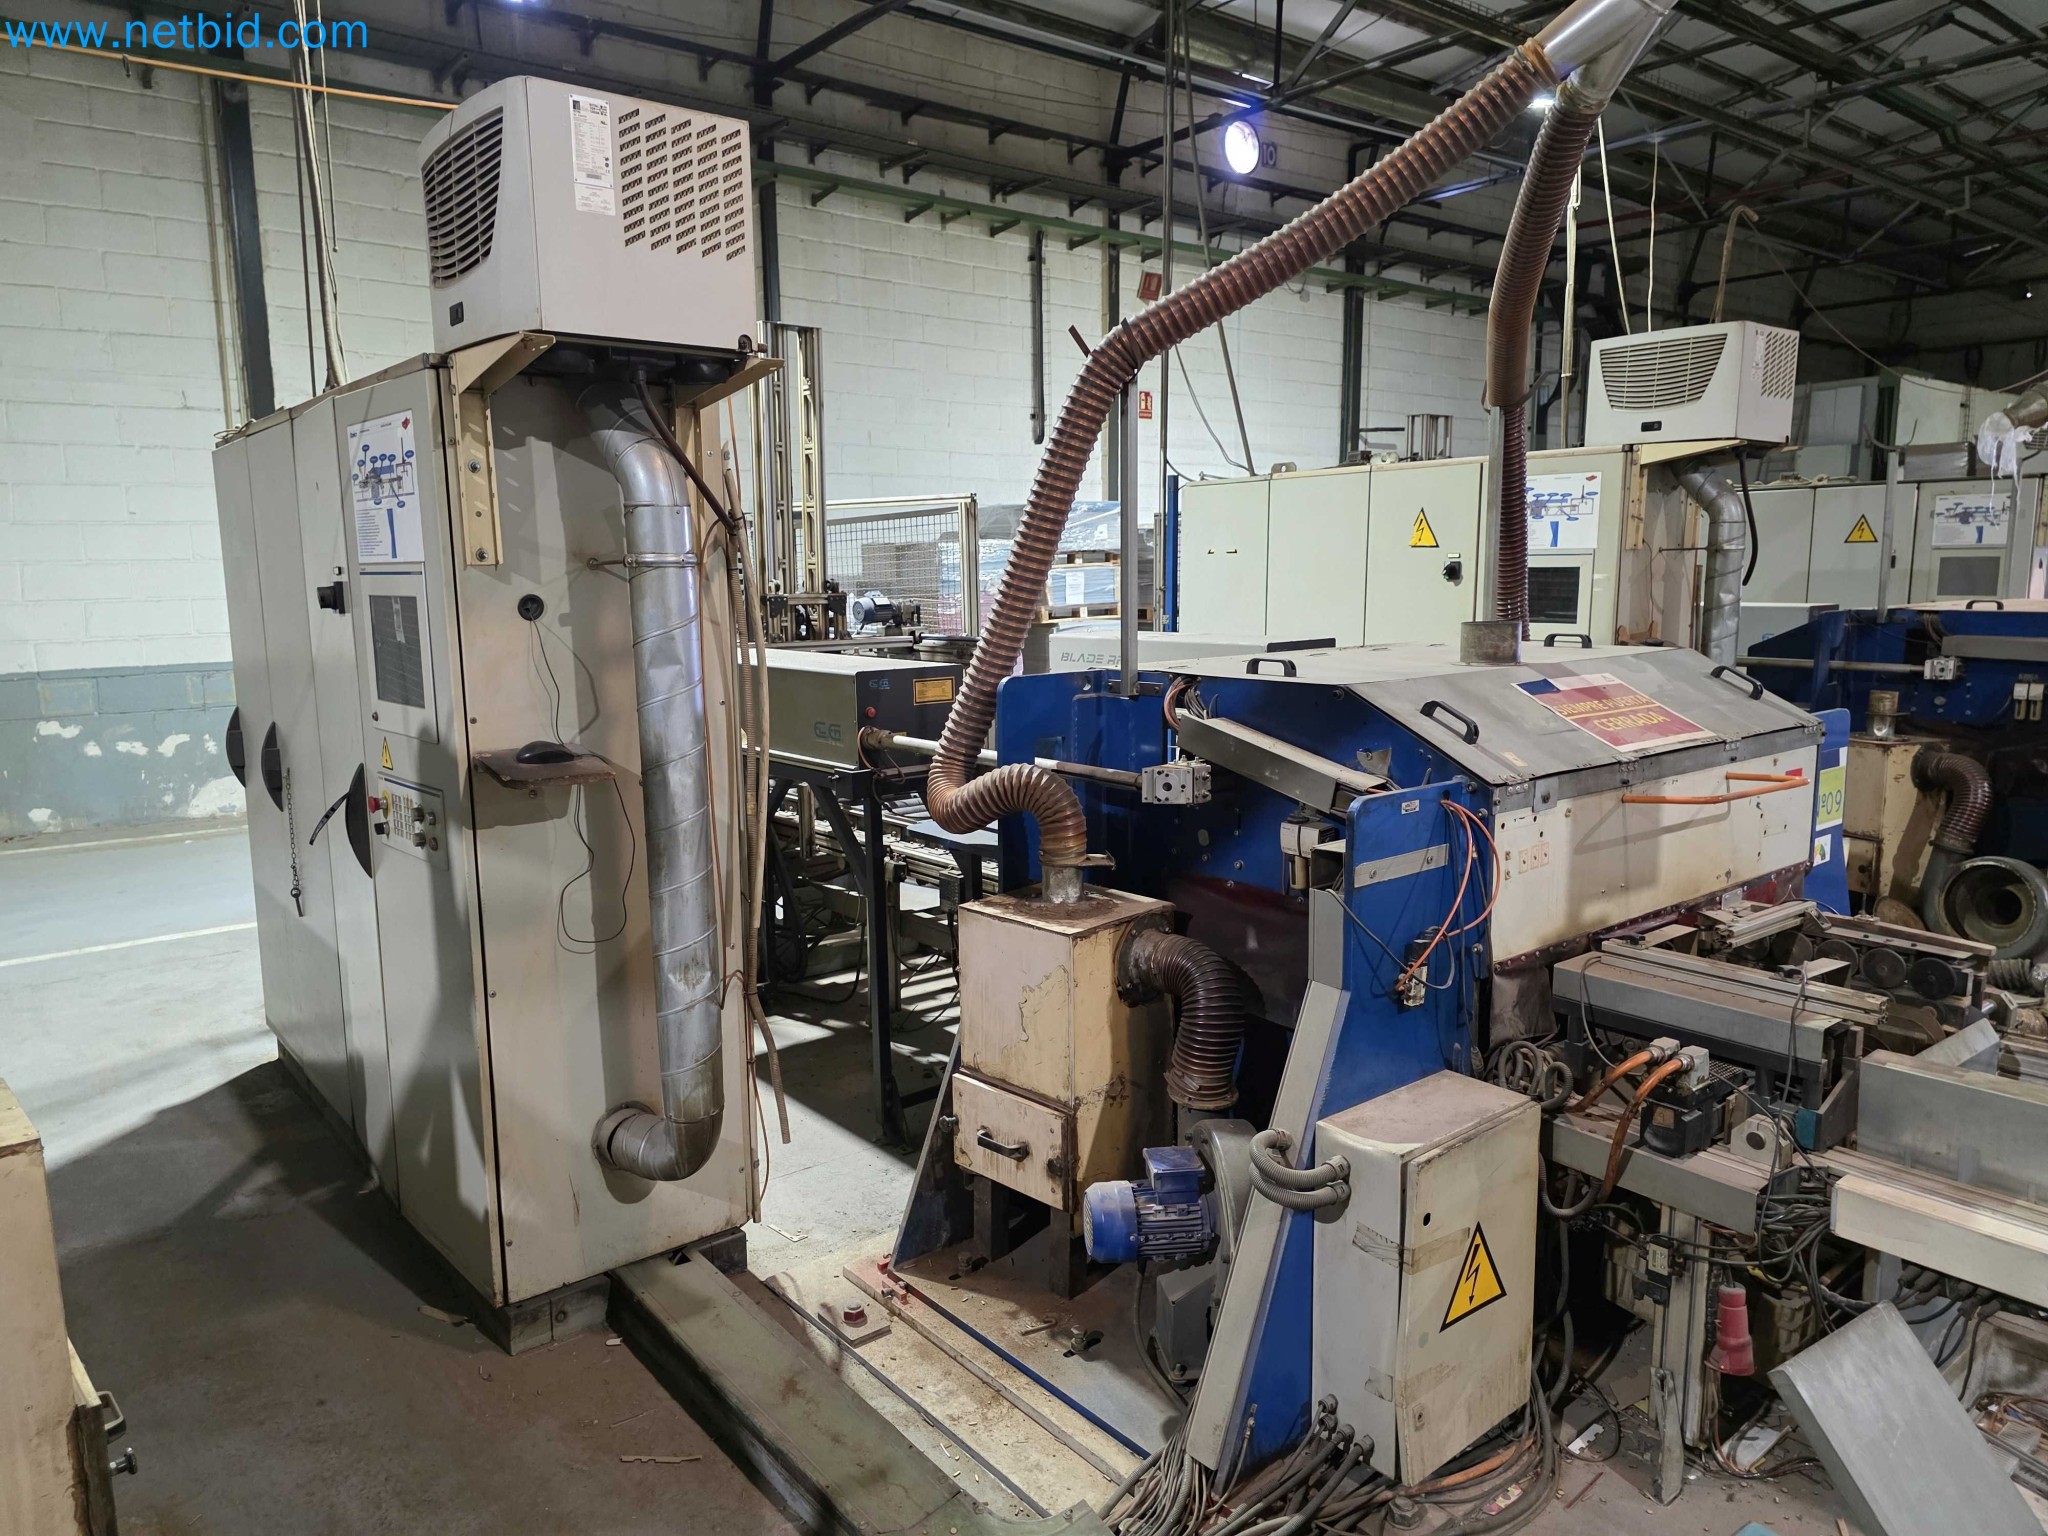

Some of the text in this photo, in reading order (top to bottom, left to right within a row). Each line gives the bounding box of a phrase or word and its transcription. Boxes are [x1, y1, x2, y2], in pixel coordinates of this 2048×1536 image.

[1060, 652, 1105, 664] BLADE
[1554, 694, 1652, 715] SIEMPRE PUERTA
[1593, 711, 1672, 731] CERRADA
